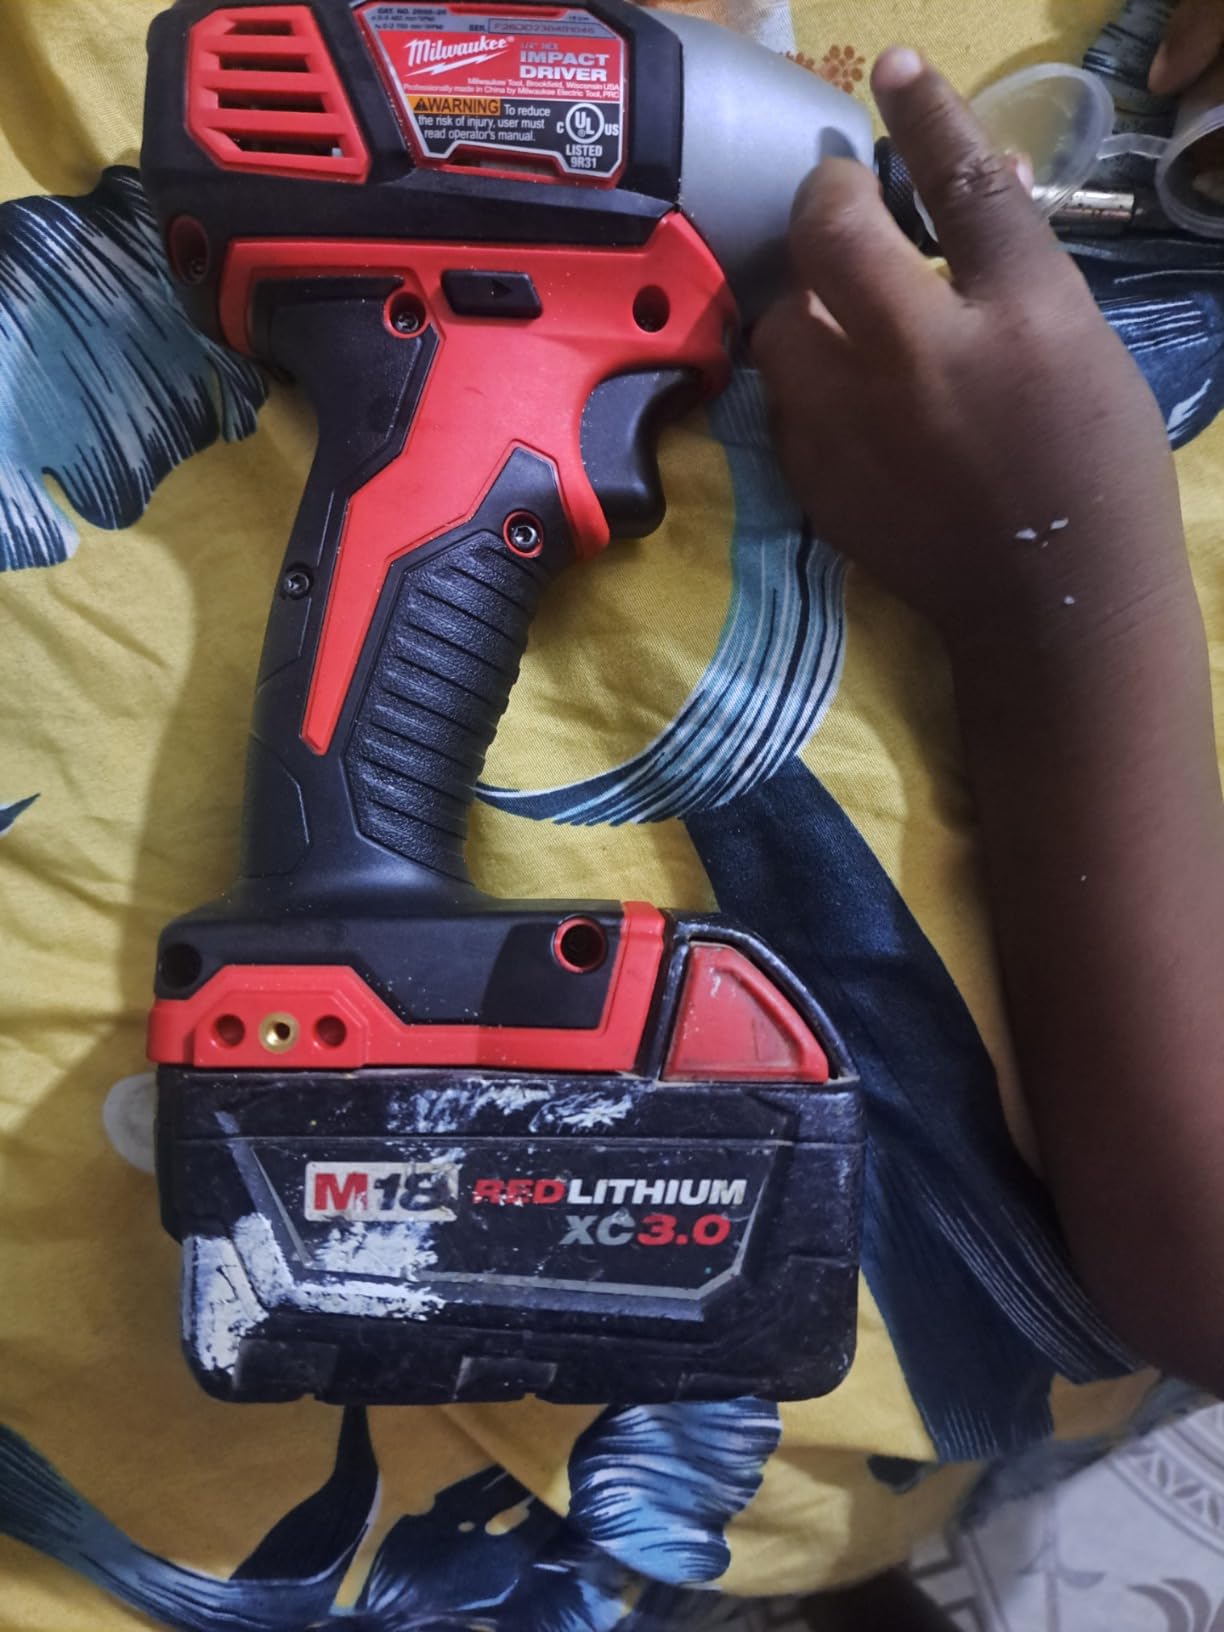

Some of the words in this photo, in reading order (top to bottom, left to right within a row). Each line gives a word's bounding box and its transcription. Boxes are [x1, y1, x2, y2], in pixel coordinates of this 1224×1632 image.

[403, 36, 508, 67] Milwaukee
[520, 51, 610, 66] IMPACT
[520, 65, 607, 81] DRIVER
[403, 84, 453, 93] Professionally
[506, 87, 517, 95] by
[518, 87, 556, 95] Milwaukee
[467, 78, 506, 86] Milwaukee
[566, 81, 602, 90] Wisconsin
[603, 83, 619, 91] USA
[428, 98, 499, 113] WARNING
[504, 104, 515, 115] To
[518, 105, 551, 116] reduce
[418, 115, 433, 125] the
[436, 115, 453, 126] risk
[455, 116, 465, 126] of
[467, 117, 496, 130] injury,
[498, 119, 518, 128] user
[521, 119, 545, 129] must
[574, 111, 595, 135] UL
[604, 123, 619, 136] US
[424, 129, 446, 139] read
[448, 129, 496, 141] operator's
[498, 130, 536, 141] manual.
[565, 144, 603, 156] LISTED
[570, 156, 597, 168] 9R31
[313, 1171, 449, 1212] M18
